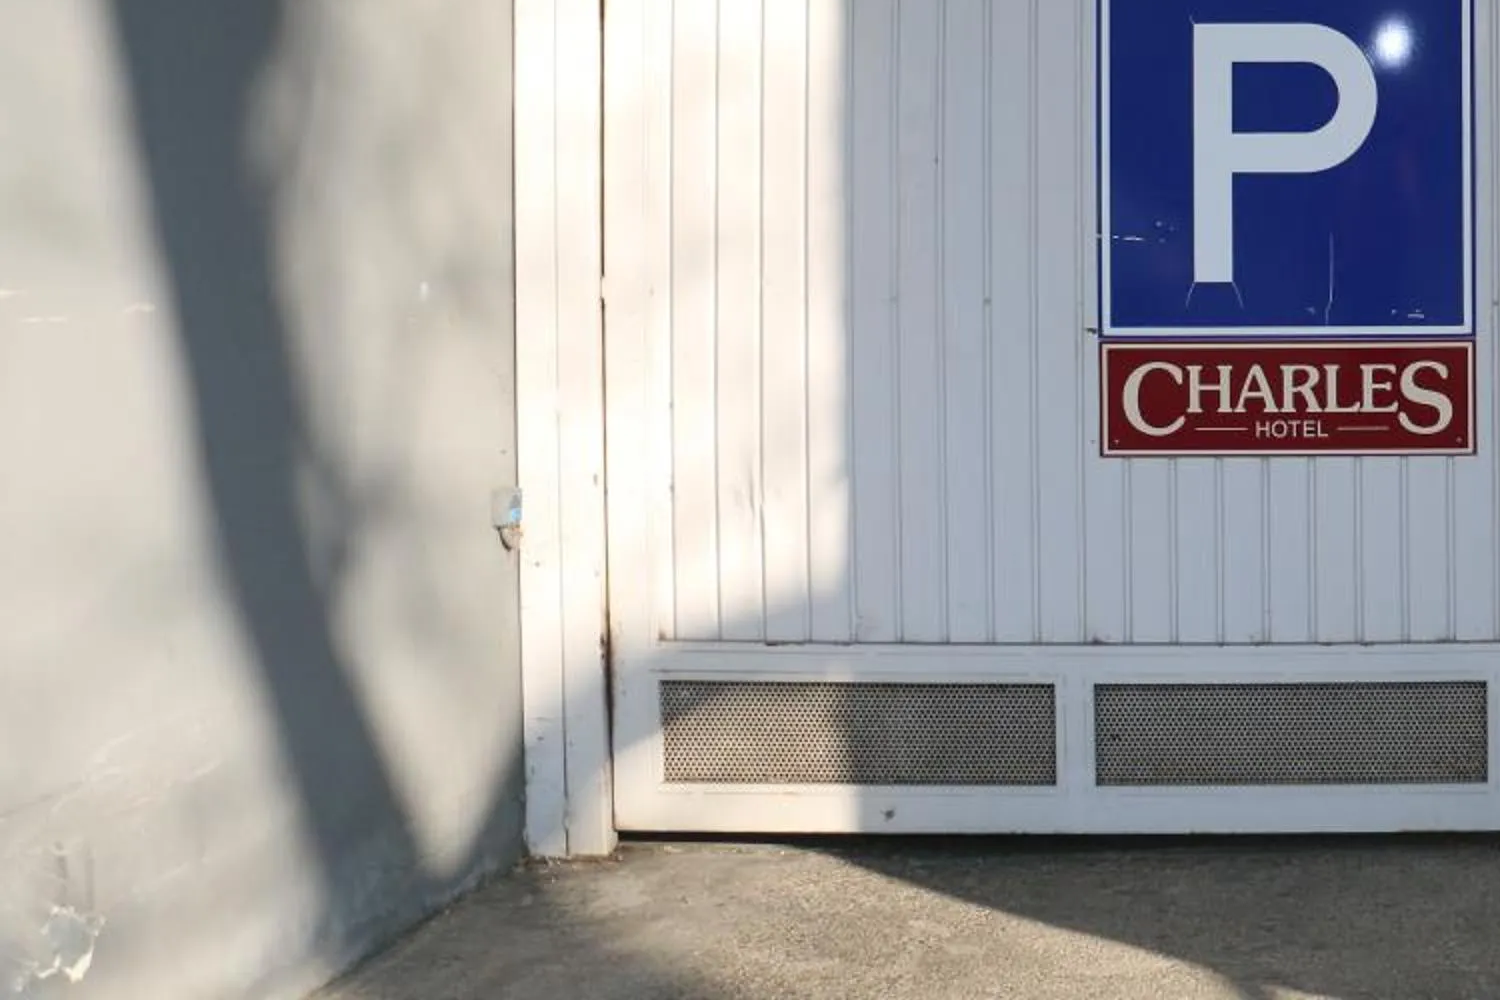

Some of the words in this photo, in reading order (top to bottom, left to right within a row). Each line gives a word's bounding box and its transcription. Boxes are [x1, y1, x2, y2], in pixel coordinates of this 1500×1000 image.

[1194, 23, 1378, 283] P
[1122, 360, 1453, 436] CHARLES
[1255, 420, 1328, 438] HOTEL
